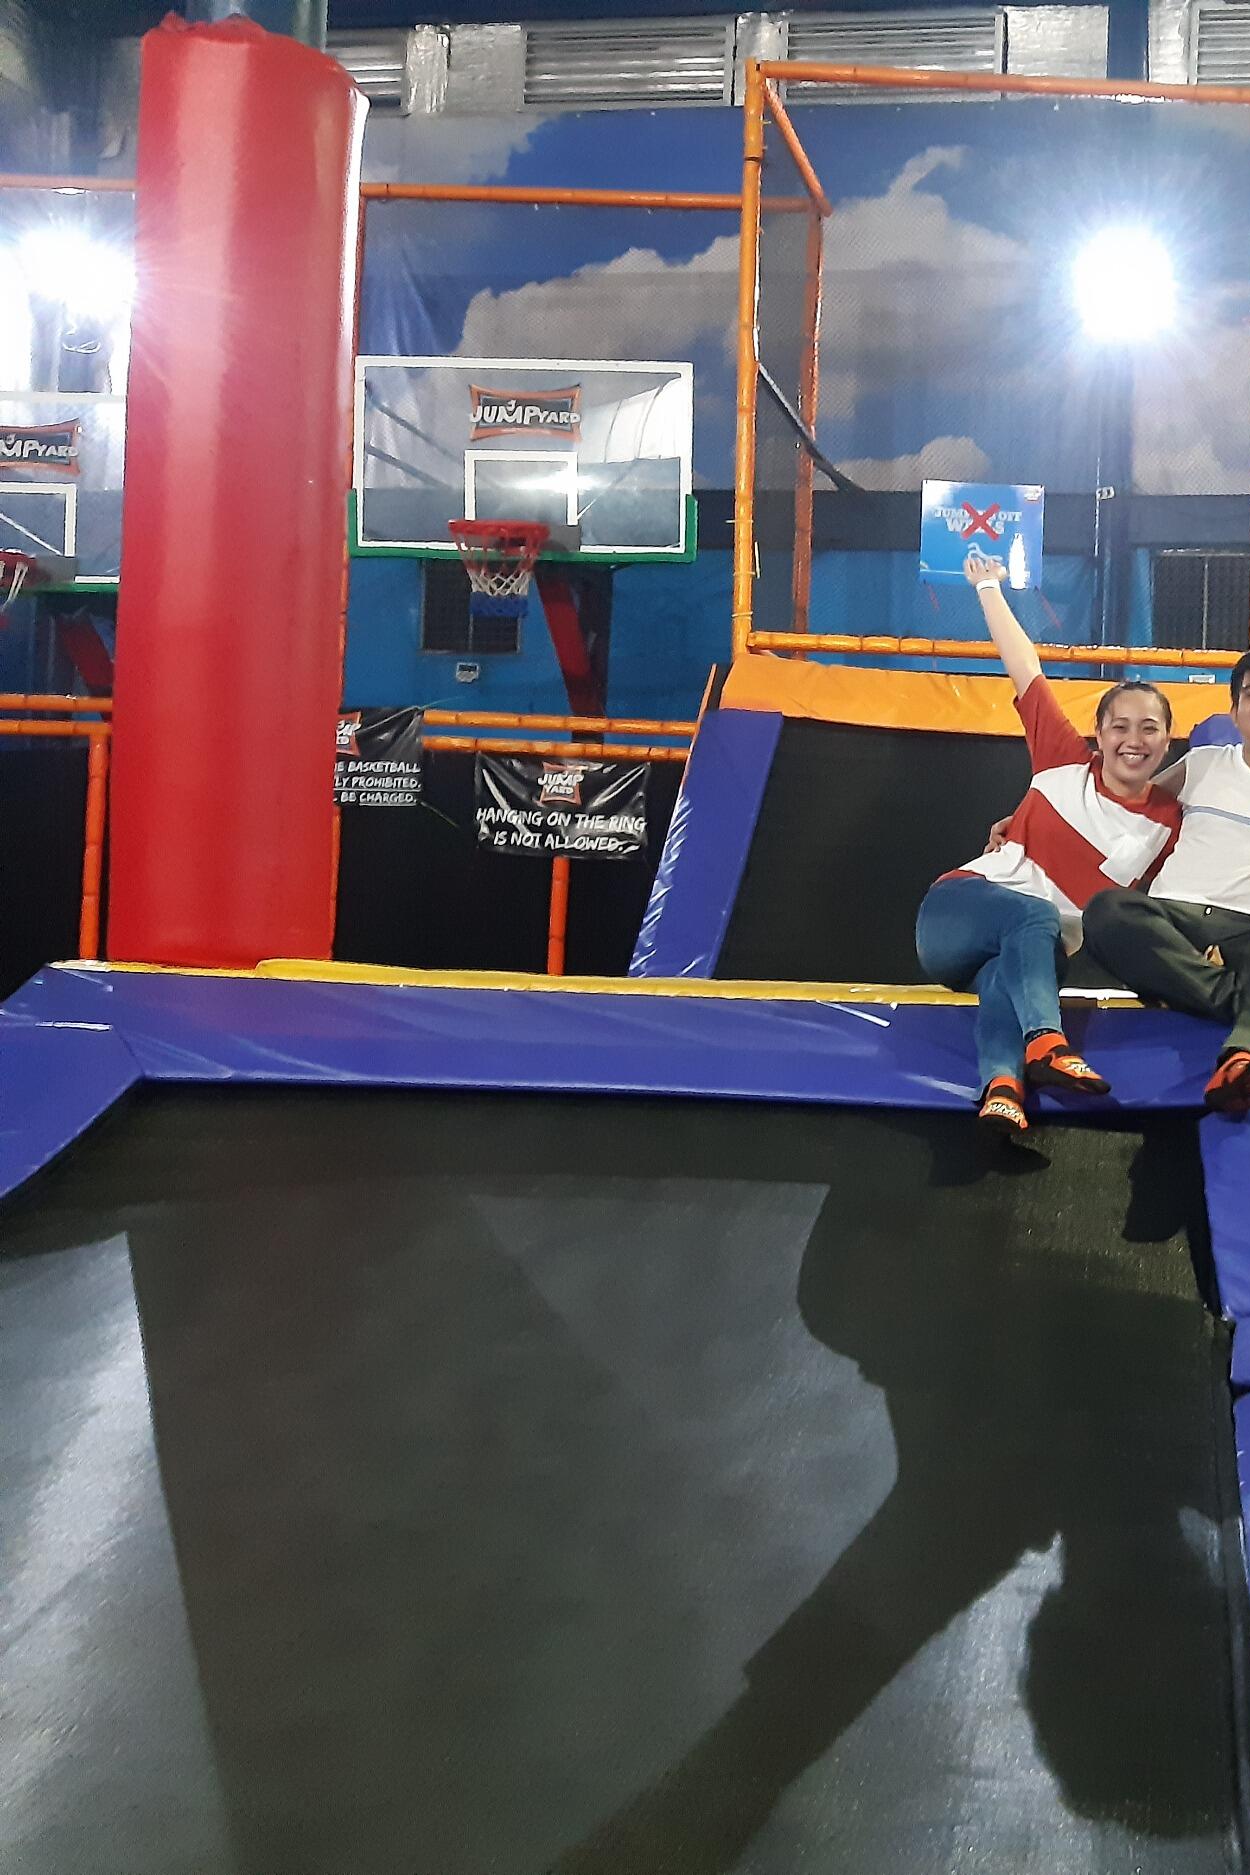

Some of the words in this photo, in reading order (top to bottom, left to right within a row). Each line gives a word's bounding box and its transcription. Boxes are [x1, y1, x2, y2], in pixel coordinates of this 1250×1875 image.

[348, 762, 421, 773] BASKETBALL
[351, 777, 421, 788] PROHIBITED.
[537, 773, 585, 786] JUMP
[544, 785, 574, 795] YARD
[341, 792, 356, 802] BE
[360, 792, 416, 803] CHARGED.
[476, 807, 544, 827] HANGING
[546, 812, 571, 827] ON
[575, 813, 606, 830] THE
[608, 815, 647, 833] RING
[493, 831, 507, 845] IS
[511, 832, 542, 849] NOT
[544, 834, 624, 852] ALLOWED.
